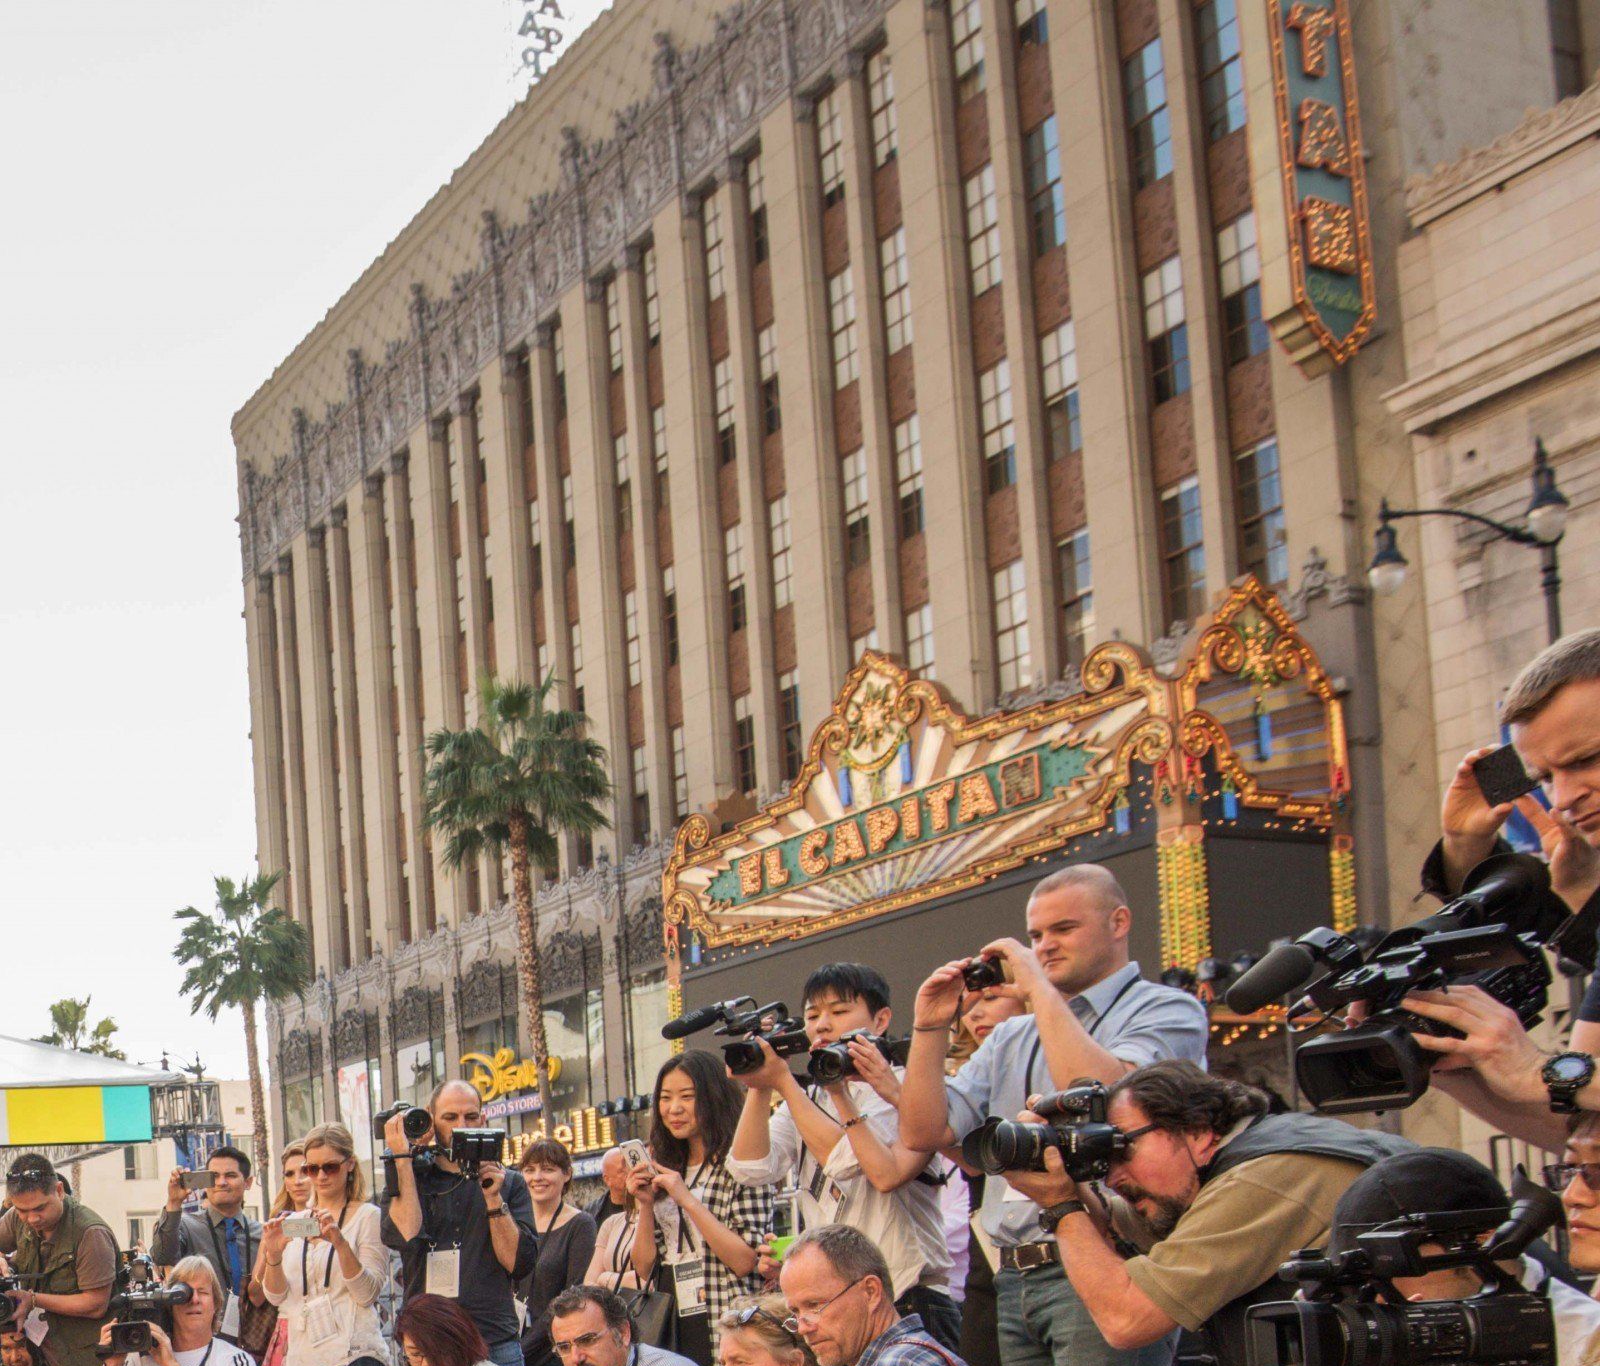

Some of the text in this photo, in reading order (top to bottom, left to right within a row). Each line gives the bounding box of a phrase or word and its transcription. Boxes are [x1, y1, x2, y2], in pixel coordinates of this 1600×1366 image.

[738, 752, 1043, 898] EL CAPITAN
[507, 1095, 541, 1114] STORE
